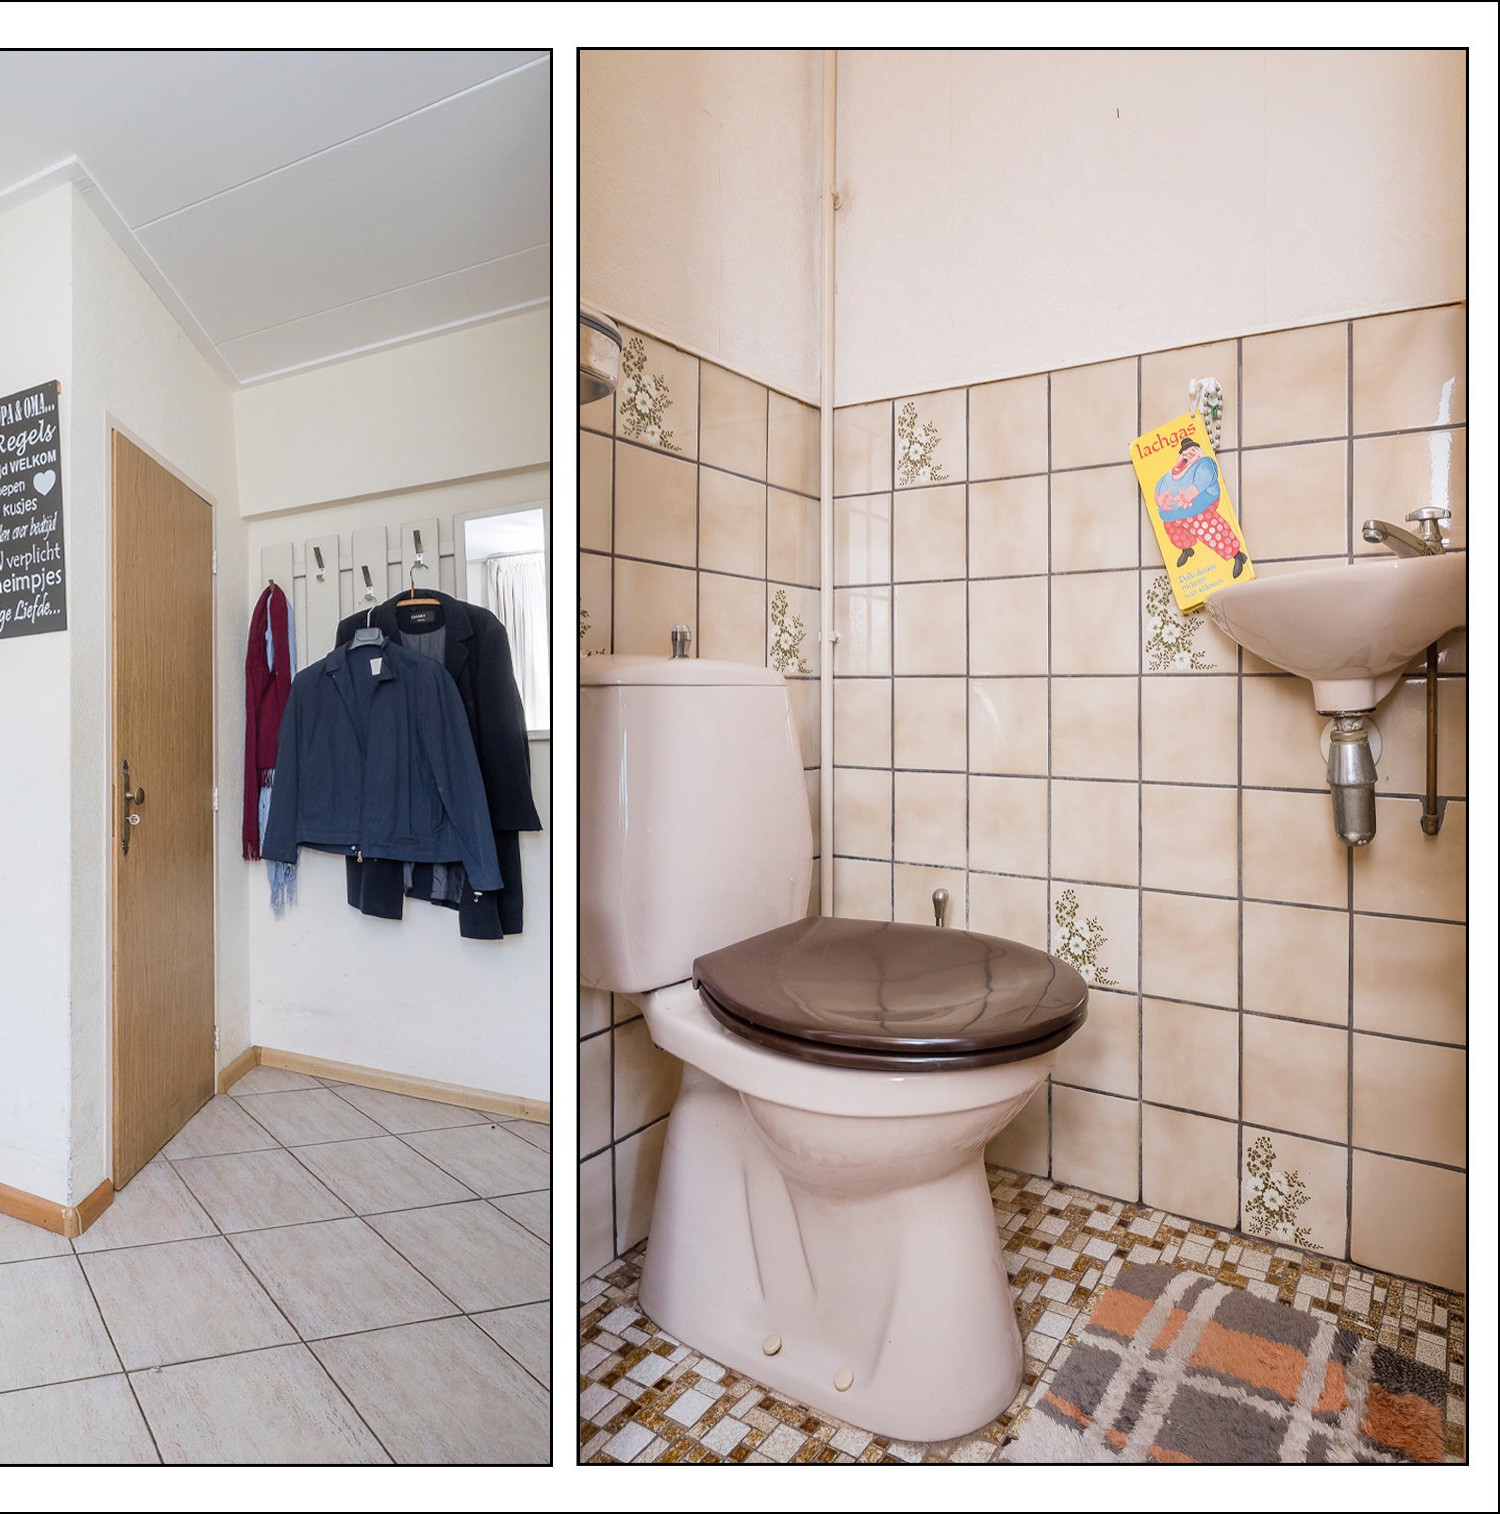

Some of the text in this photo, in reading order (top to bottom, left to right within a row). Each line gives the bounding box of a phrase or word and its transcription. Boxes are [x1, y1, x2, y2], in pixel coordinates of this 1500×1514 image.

[15, 400, 22, 422] &
[24, 392, 55, 418] OMA...
[1136, 423, 1196, 459] lachgas
[10, 449, 56, 473] WELKOM
[7, 541, 60, 570] verplicht
